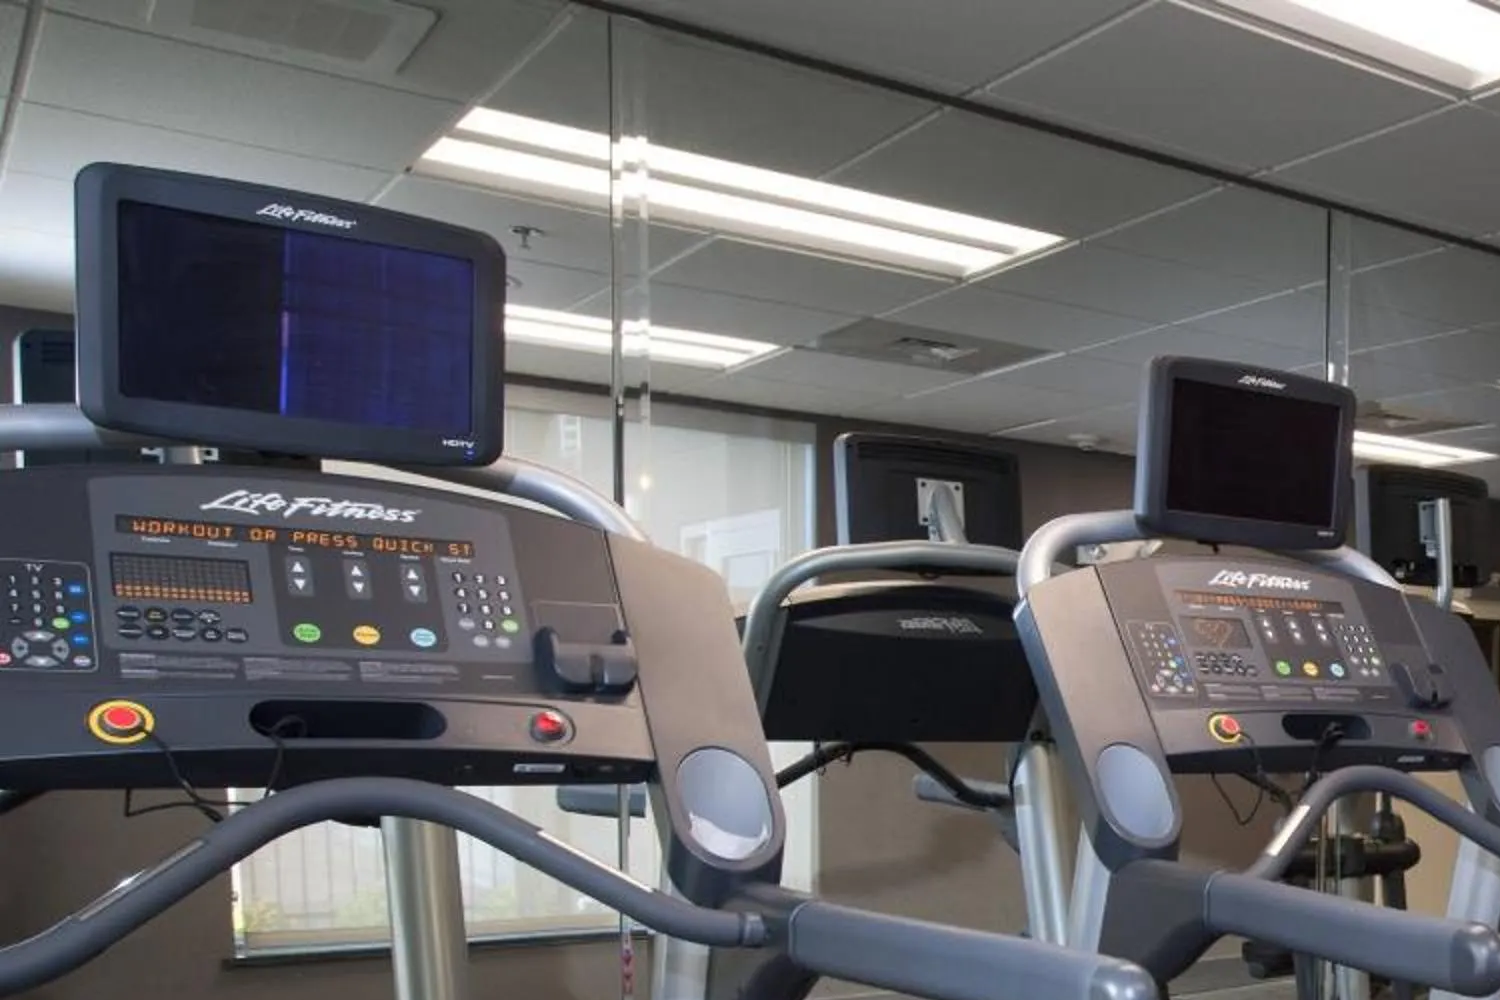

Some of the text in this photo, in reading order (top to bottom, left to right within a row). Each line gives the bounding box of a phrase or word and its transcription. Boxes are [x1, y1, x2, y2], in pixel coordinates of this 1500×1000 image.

[256, 203, 295, 219] Life
[200, 489, 420, 523] Life Fitness
[132, 519, 235, 540] WORKOUT
[249, 529, 277, 541] OR
[292, 531, 358, 549] PRESS
[372, 537, 434, 553] QUICK
[1208, 569, 1249, 588] Life
